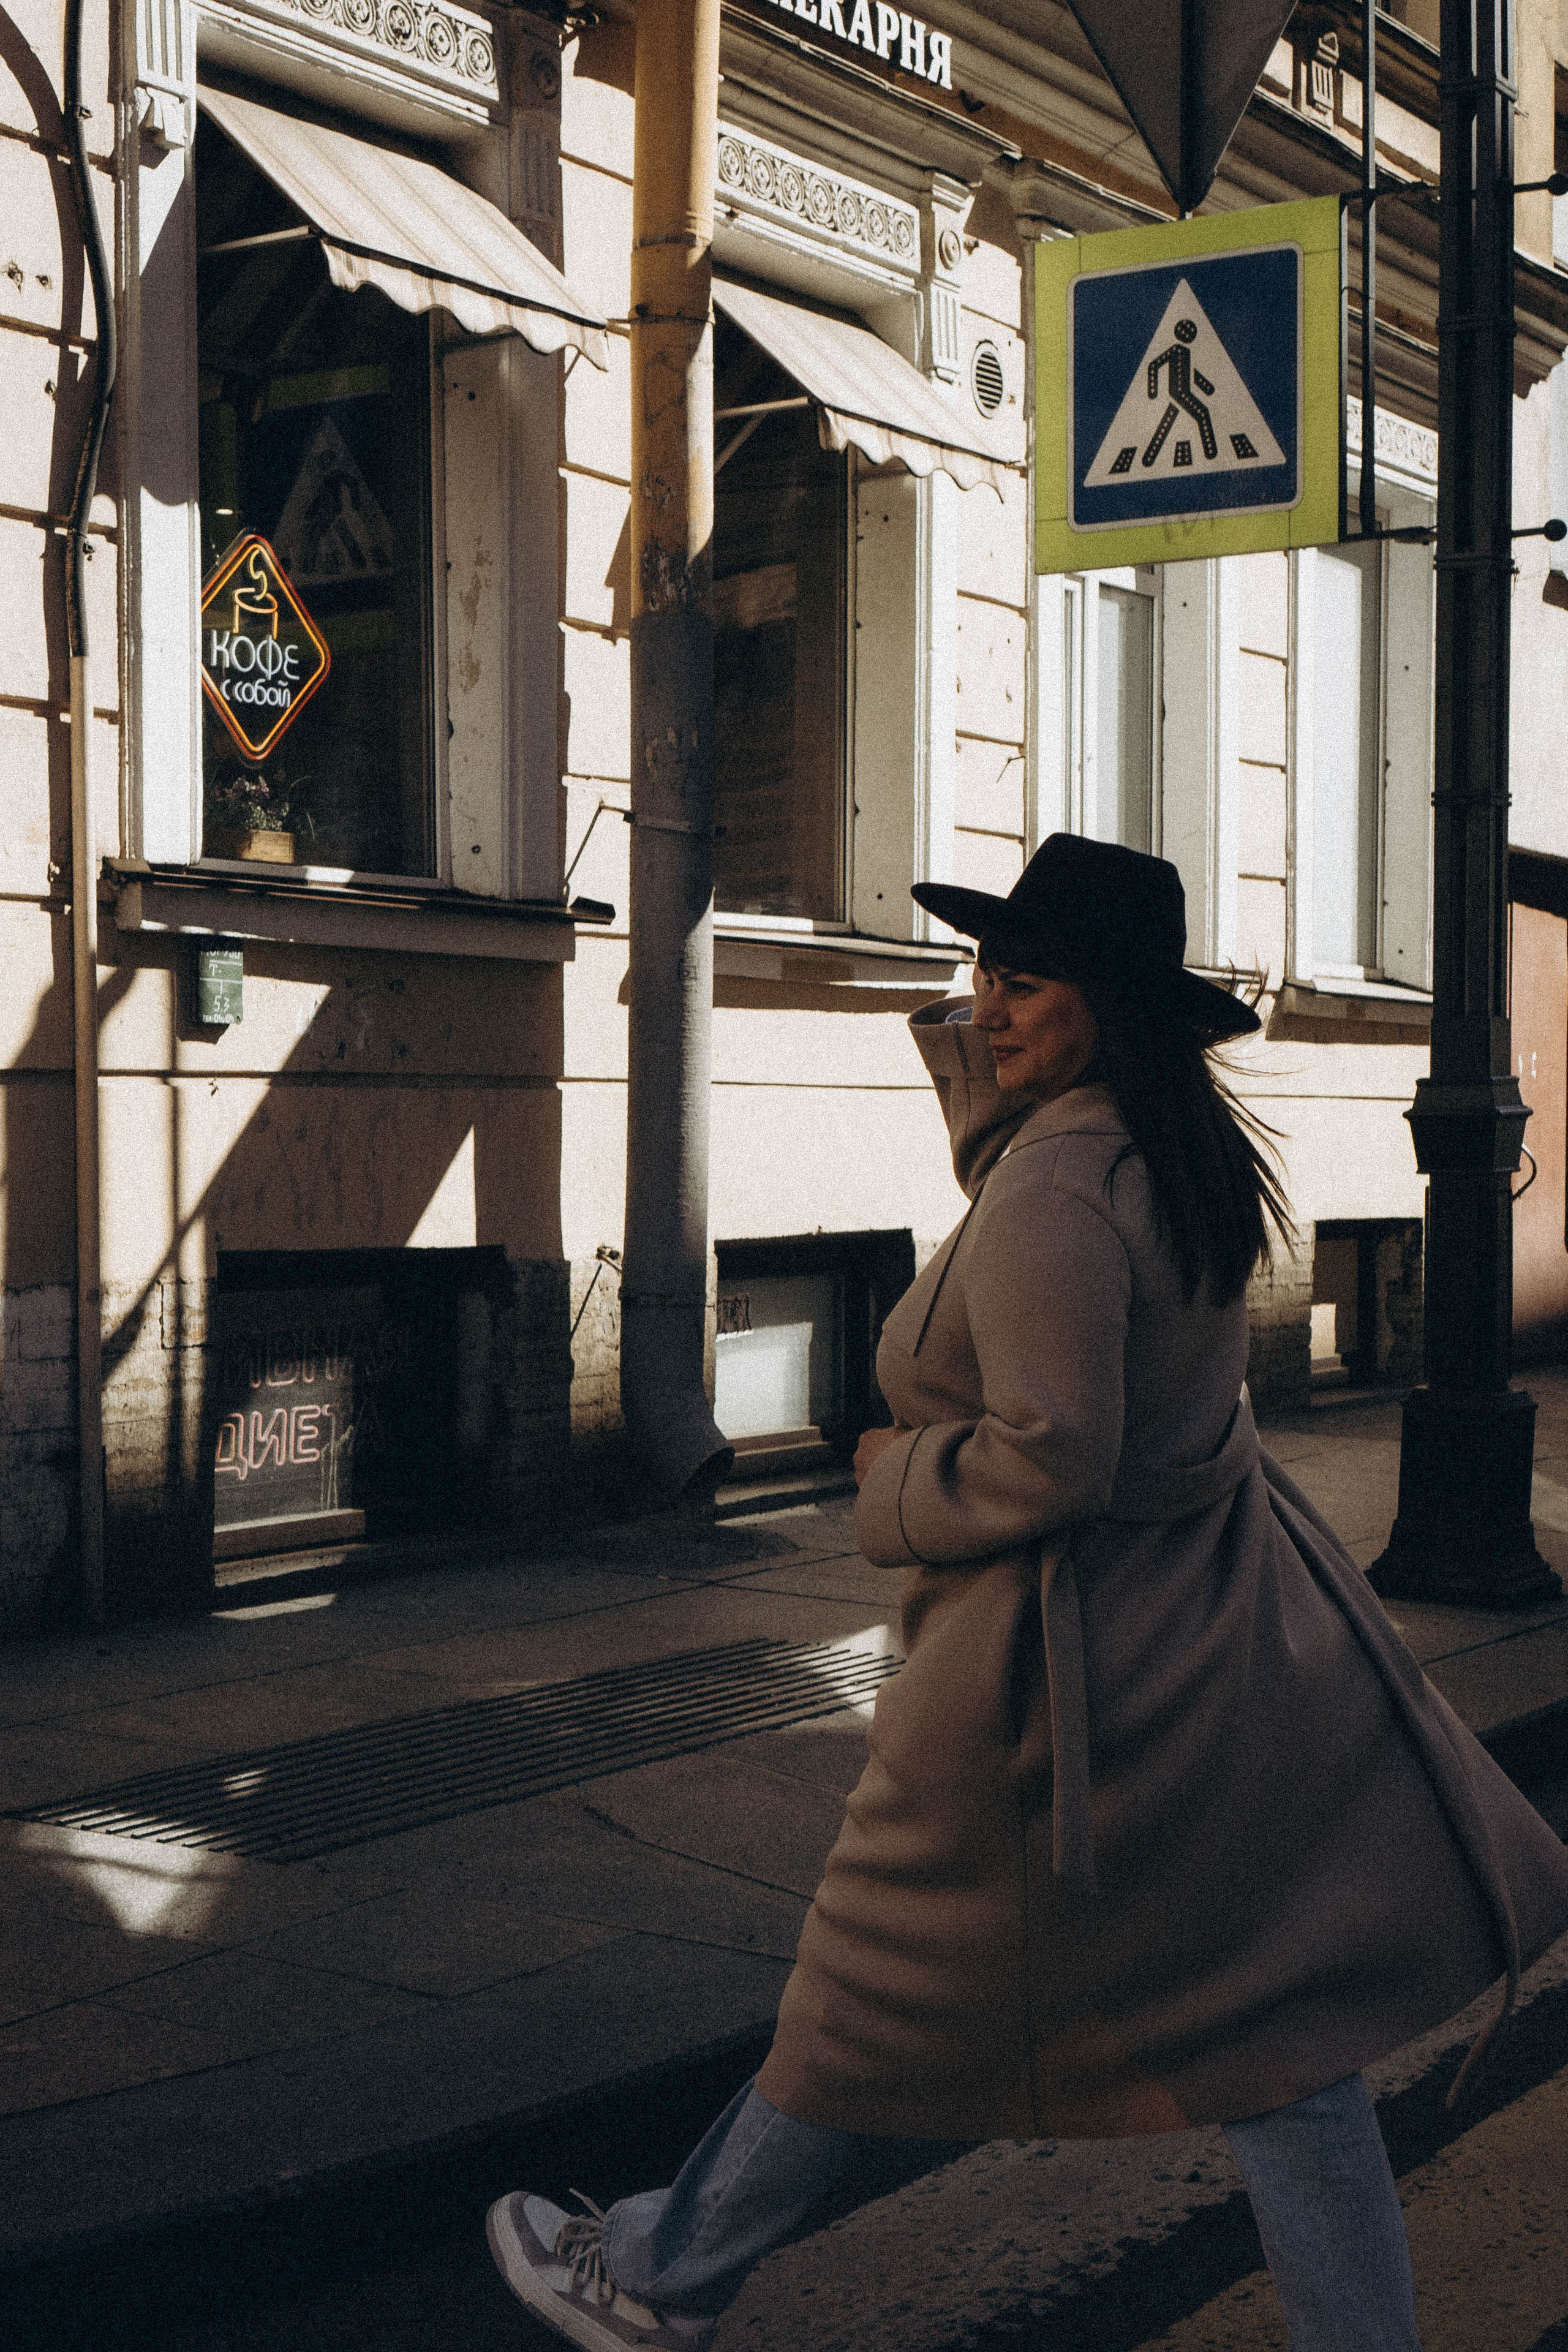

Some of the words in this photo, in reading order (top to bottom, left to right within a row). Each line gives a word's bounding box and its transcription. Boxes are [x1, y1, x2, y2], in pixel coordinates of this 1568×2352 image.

[211, 630, 300, 680] КОФЕ
[221, 679, 230, 701] с
[233, 678, 290, 707] собой
